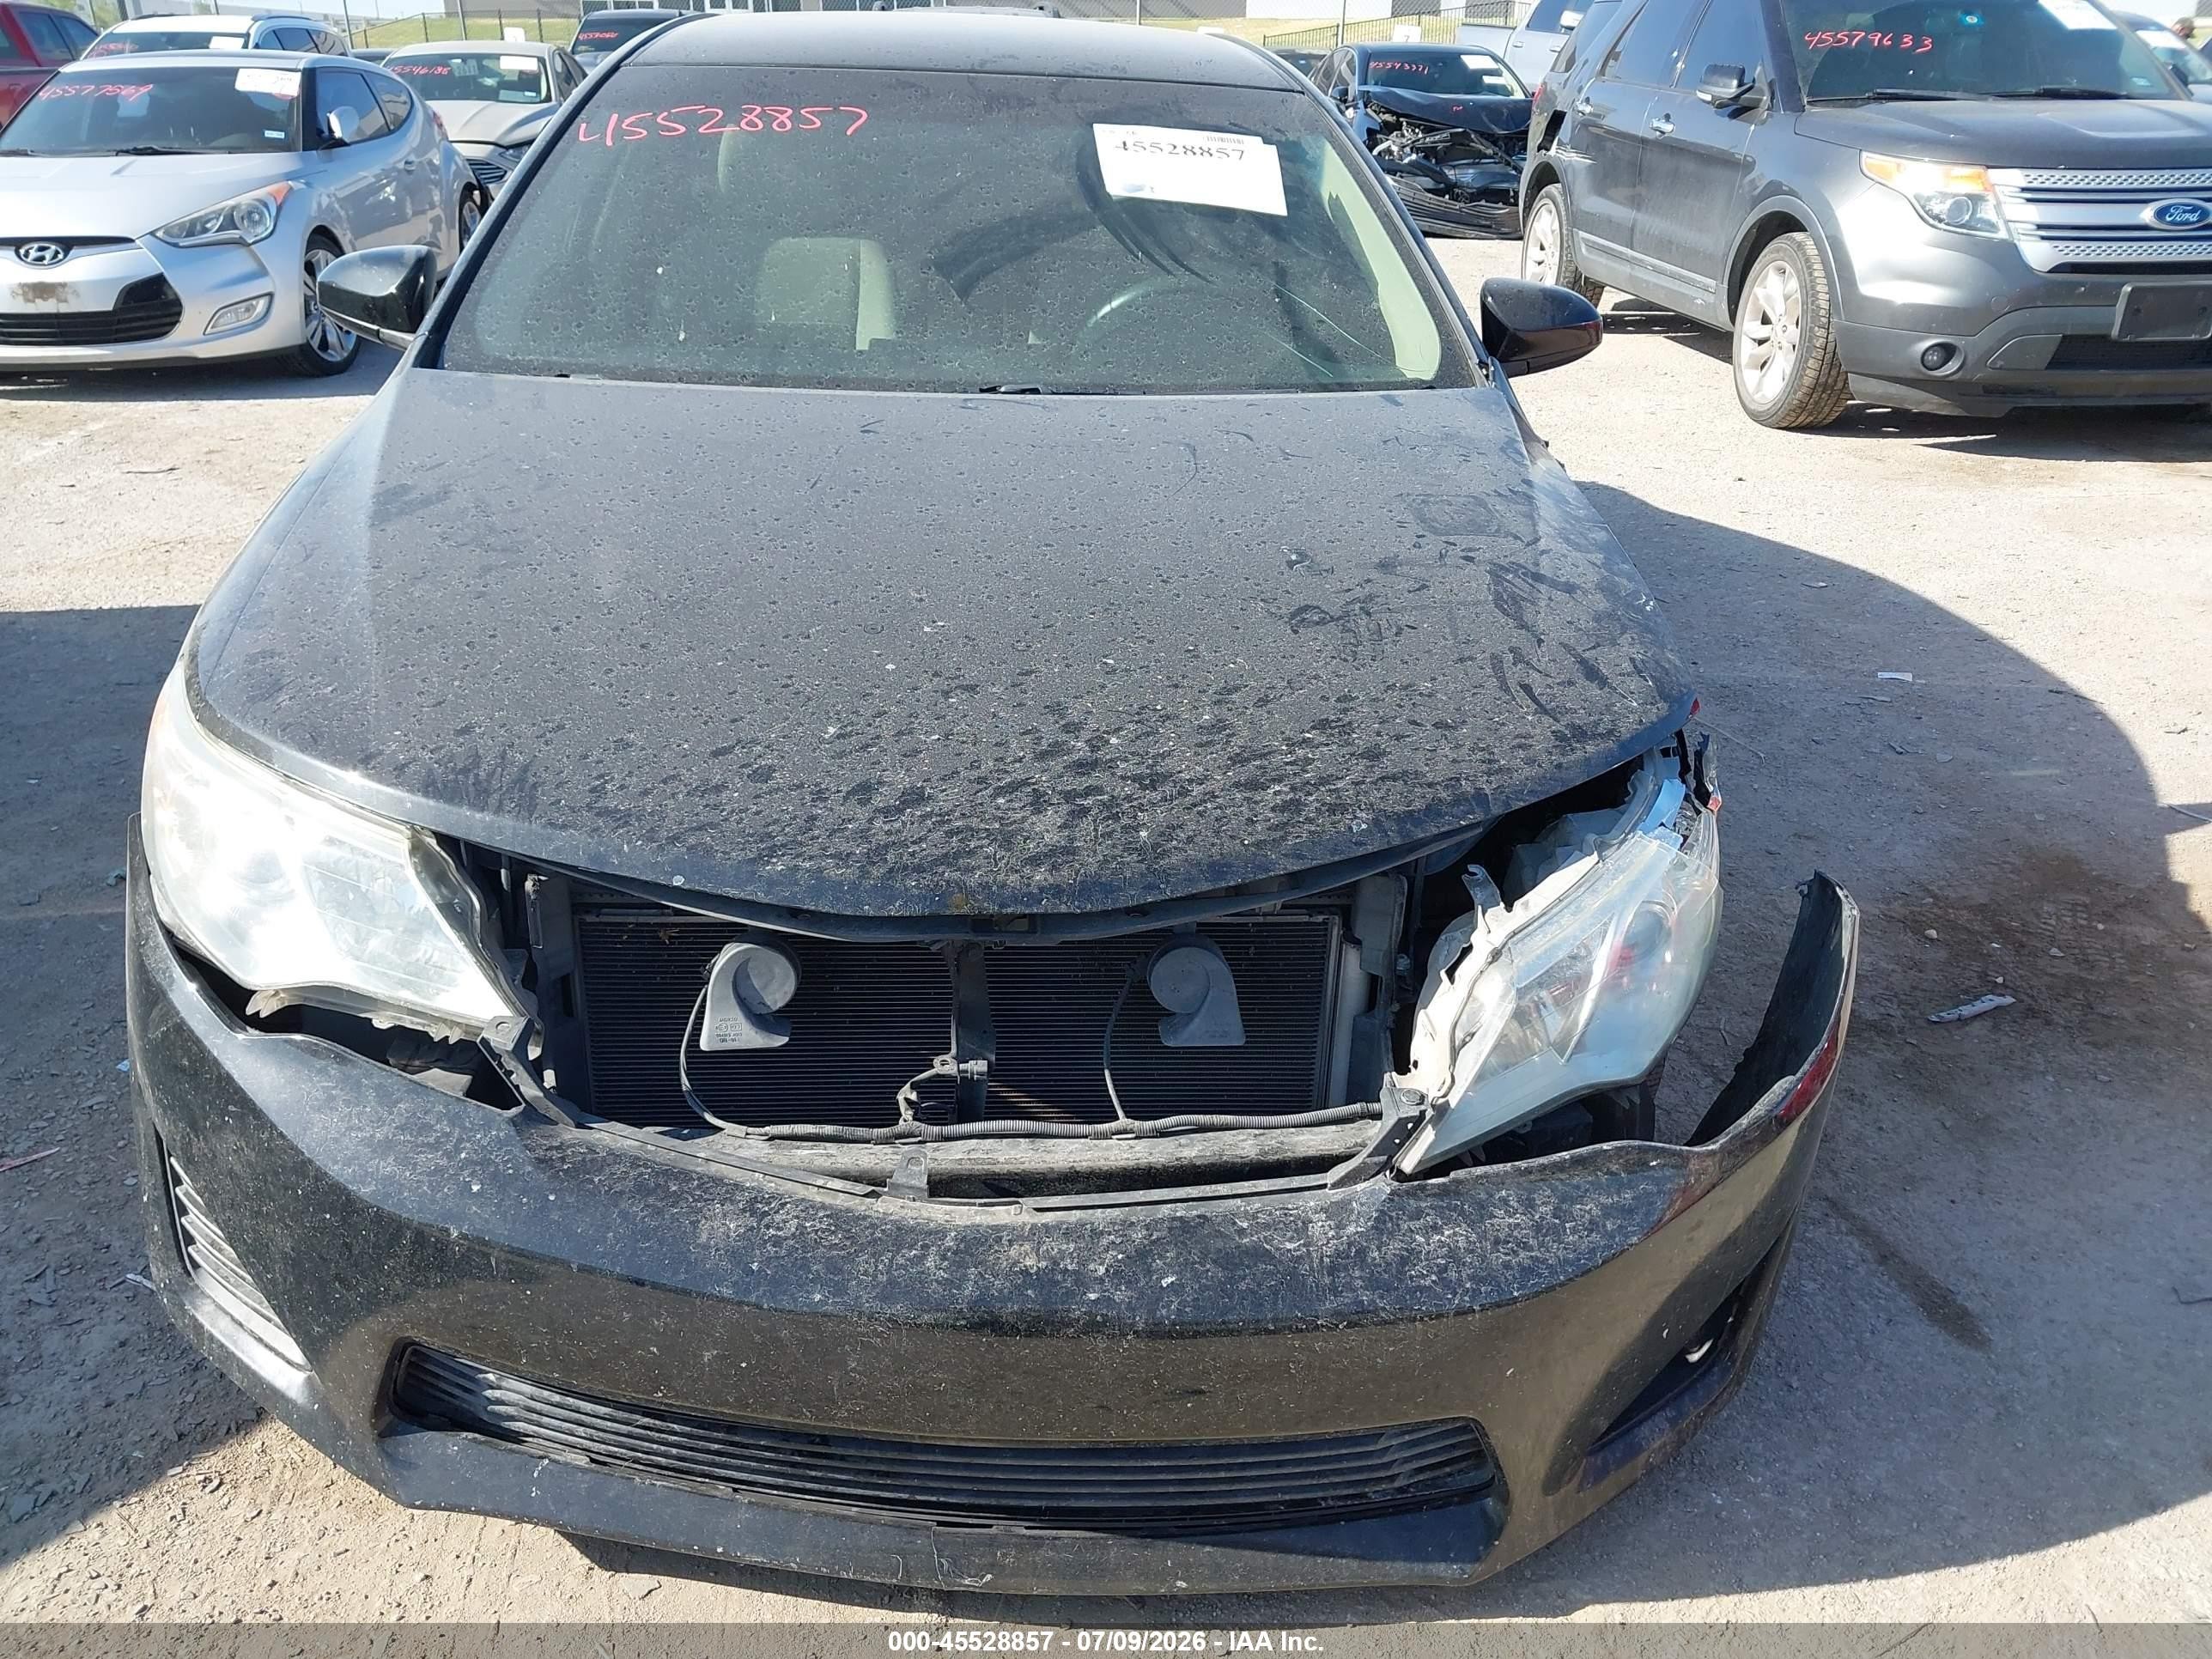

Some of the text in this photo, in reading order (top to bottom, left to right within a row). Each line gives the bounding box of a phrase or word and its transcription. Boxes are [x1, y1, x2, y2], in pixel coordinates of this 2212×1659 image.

[1804, 30, 1934, 54] 45579633
[578, 104, 869, 147] 45528857
[1115, 140, 1245, 161] 45528857
[2165, 204, 2203, 222] Ford
